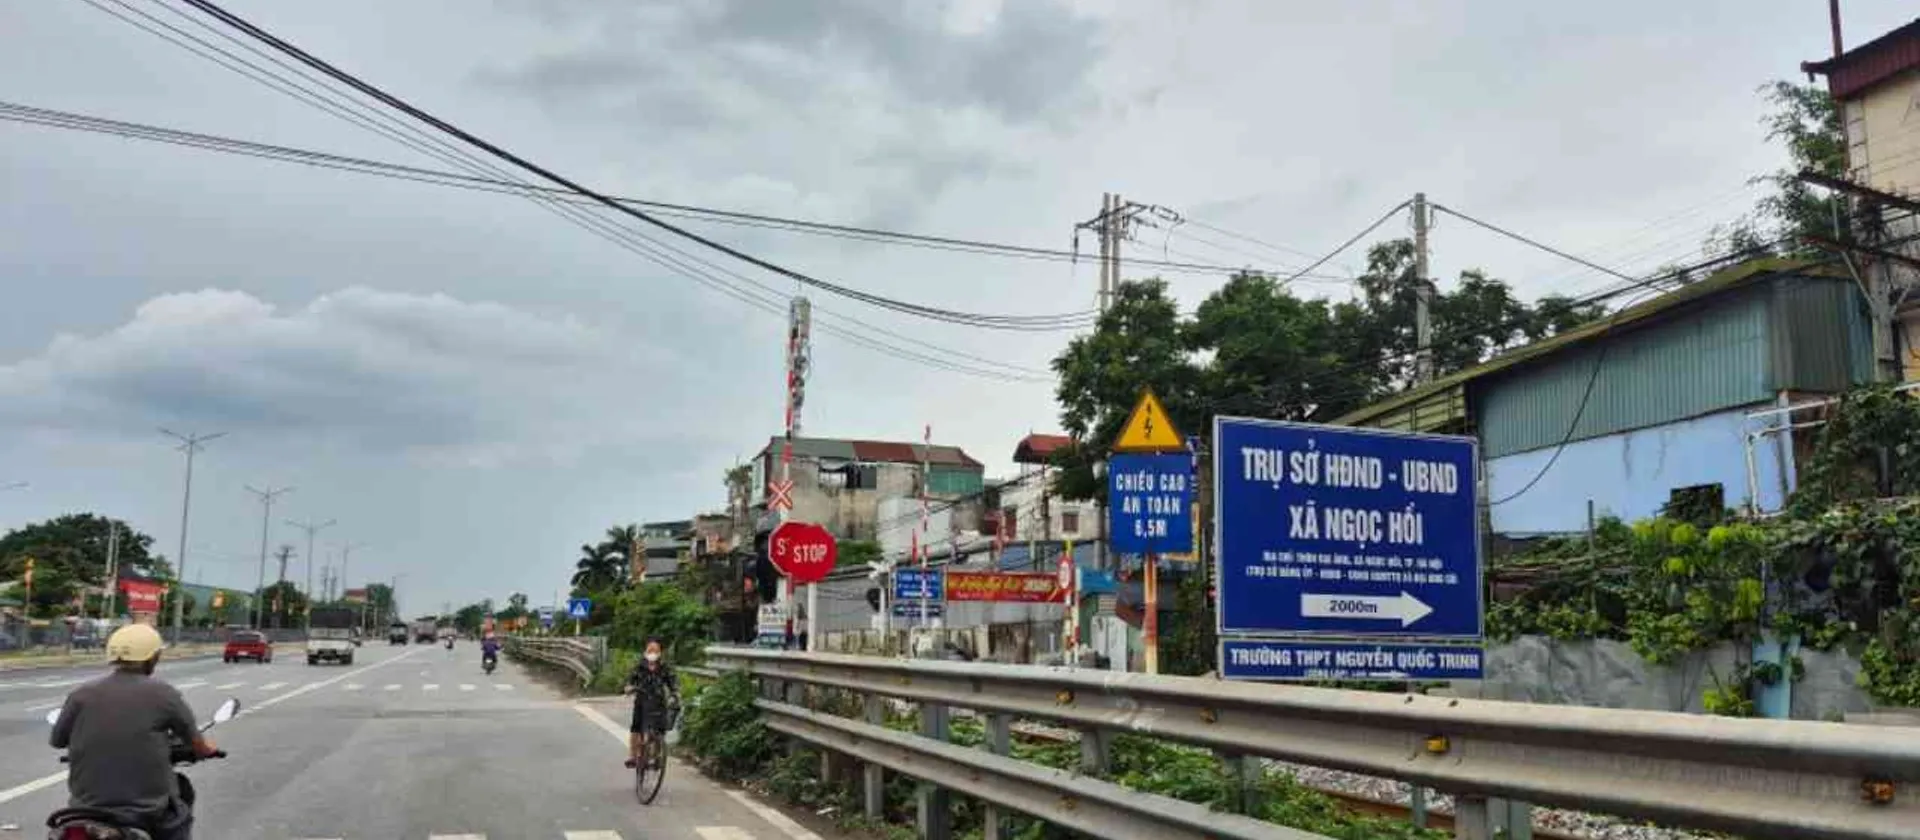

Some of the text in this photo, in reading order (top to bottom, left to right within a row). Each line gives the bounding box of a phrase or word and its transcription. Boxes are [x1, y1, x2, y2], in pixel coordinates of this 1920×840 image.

[1242, 447, 1283, 490] TRỤ
[1290, 439, 1321, 484] SỞ
[1325, 453, 1382, 489] HĐND
[1403, 460, 1458, 494] UBND
[1160, 473, 1185, 492] CAO
[1123, 494, 1181, 515] AN TOÀN
[1289, 500, 1319, 539] XÃ
[1324, 507, 1382, 550] NGỌC
[793, 544, 827, 564] STOP
[1329, 600, 1377, 613] 2000m
[1230, 645, 1292, 666] TRƯỜNG
[1296, 649, 1331, 666] THPT
